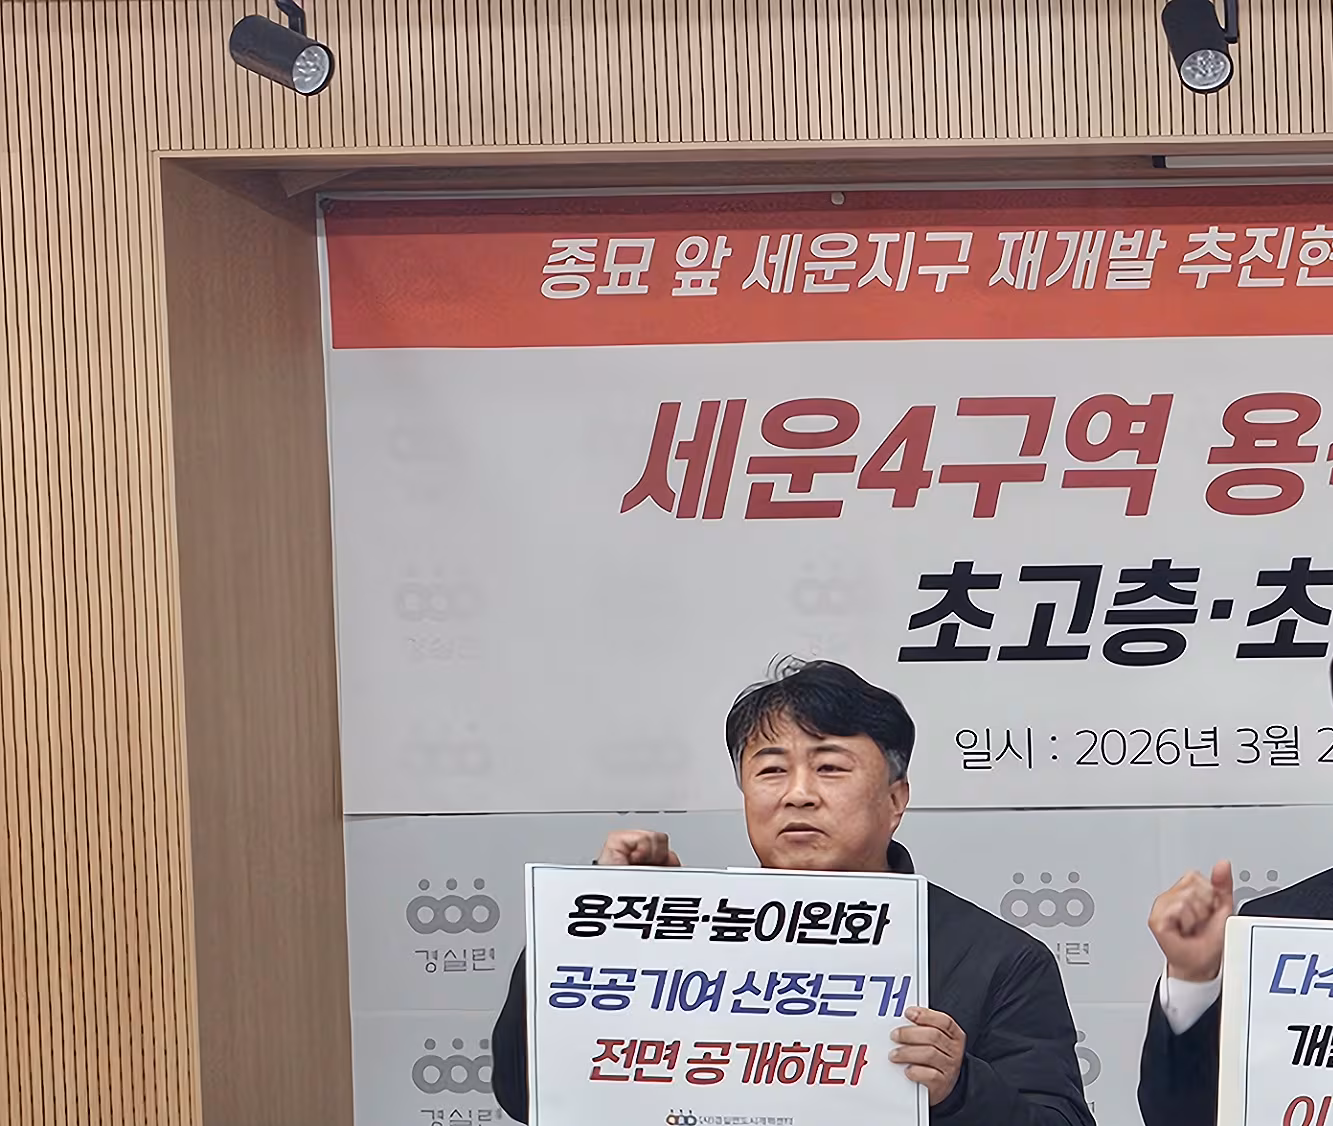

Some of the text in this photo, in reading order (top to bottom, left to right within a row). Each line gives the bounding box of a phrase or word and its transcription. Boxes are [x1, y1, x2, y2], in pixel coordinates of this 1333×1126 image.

[540, 238, 656, 300] 종묘
[671, 234, 721, 298] 앞
[741, 231, 974, 294] 세운지구
[988, 229, 1168, 291] 재개발
[619, 393, 1175, 520] 세운4구역
[955, 727, 1033, 770] 일시
[1075, 726, 1220, 768] 2026년
[1236, 725, 1300, 767] 3월
[414, 947, 496, 974] 경실련
[548, 965, 912, 1018] 공공기여 산정근거
[588, 1038, 869, 1086] 전면 공개하라
